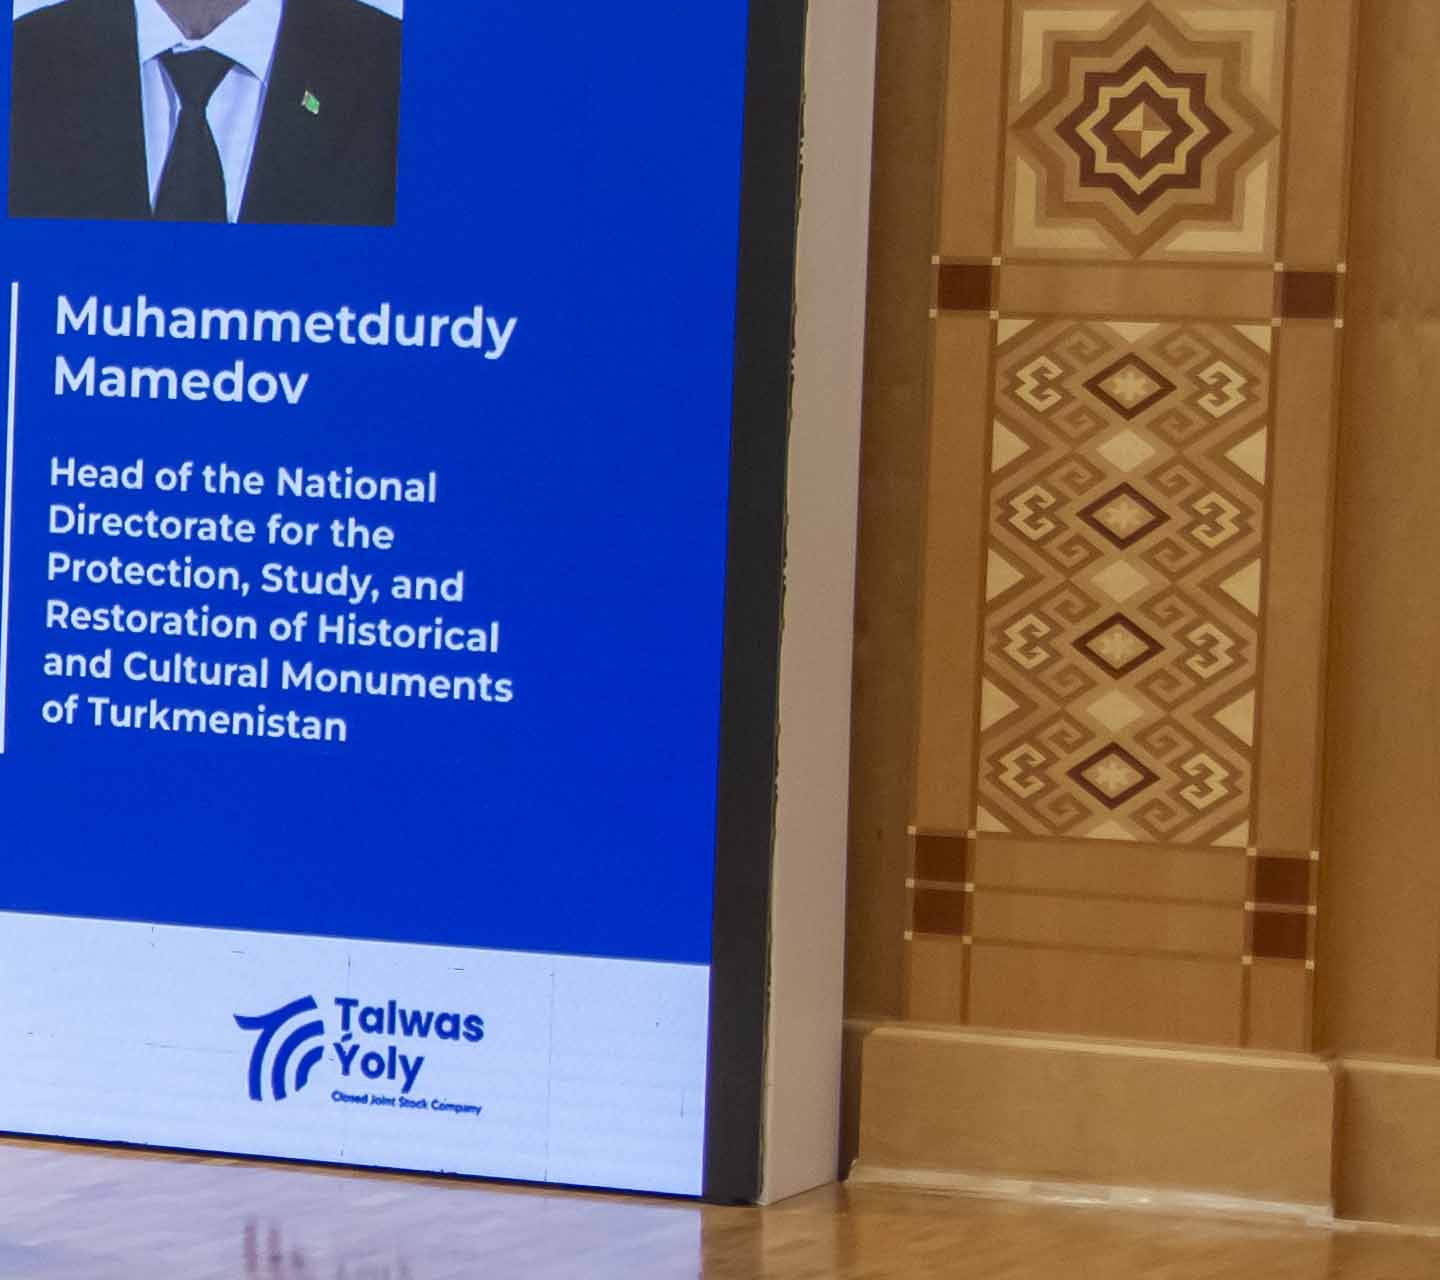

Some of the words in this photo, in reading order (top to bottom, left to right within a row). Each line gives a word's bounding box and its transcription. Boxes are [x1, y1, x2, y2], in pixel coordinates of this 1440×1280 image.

[56, 295, 518, 360] Muhammetdurdy
[54, 355, 309, 404] Mamedov
[50, 456, 144, 490] Head
[155, 460, 194, 492] of
[202, 463, 265, 495] the
[277, 466, 437, 503] National
[49, 502, 256, 543] Directorate
[266, 513, 320, 546] for
[330, 517, 395, 550] the
[47, 551, 250, 597] Protection,
[261, 562, 380, 605] Study,
[391, 570, 464, 602] and
[46, 599, 257, 640] Restoration
[269, 611, 308, 642] of
[318, 612, 499, 653] Historical
[43, 648, 112, 679] and
[123, 651, 269, 689] Cultural
[281, 660, 513, 703] Monuments
[42, 693, 80, 725] of
[87, 696, 347, 742] Turkmenistan
[334, 997, 484, 1042] Talwas
[333, 1033, 425, 1094] Ýoly
[431, 1099, 482, 1115] Company
